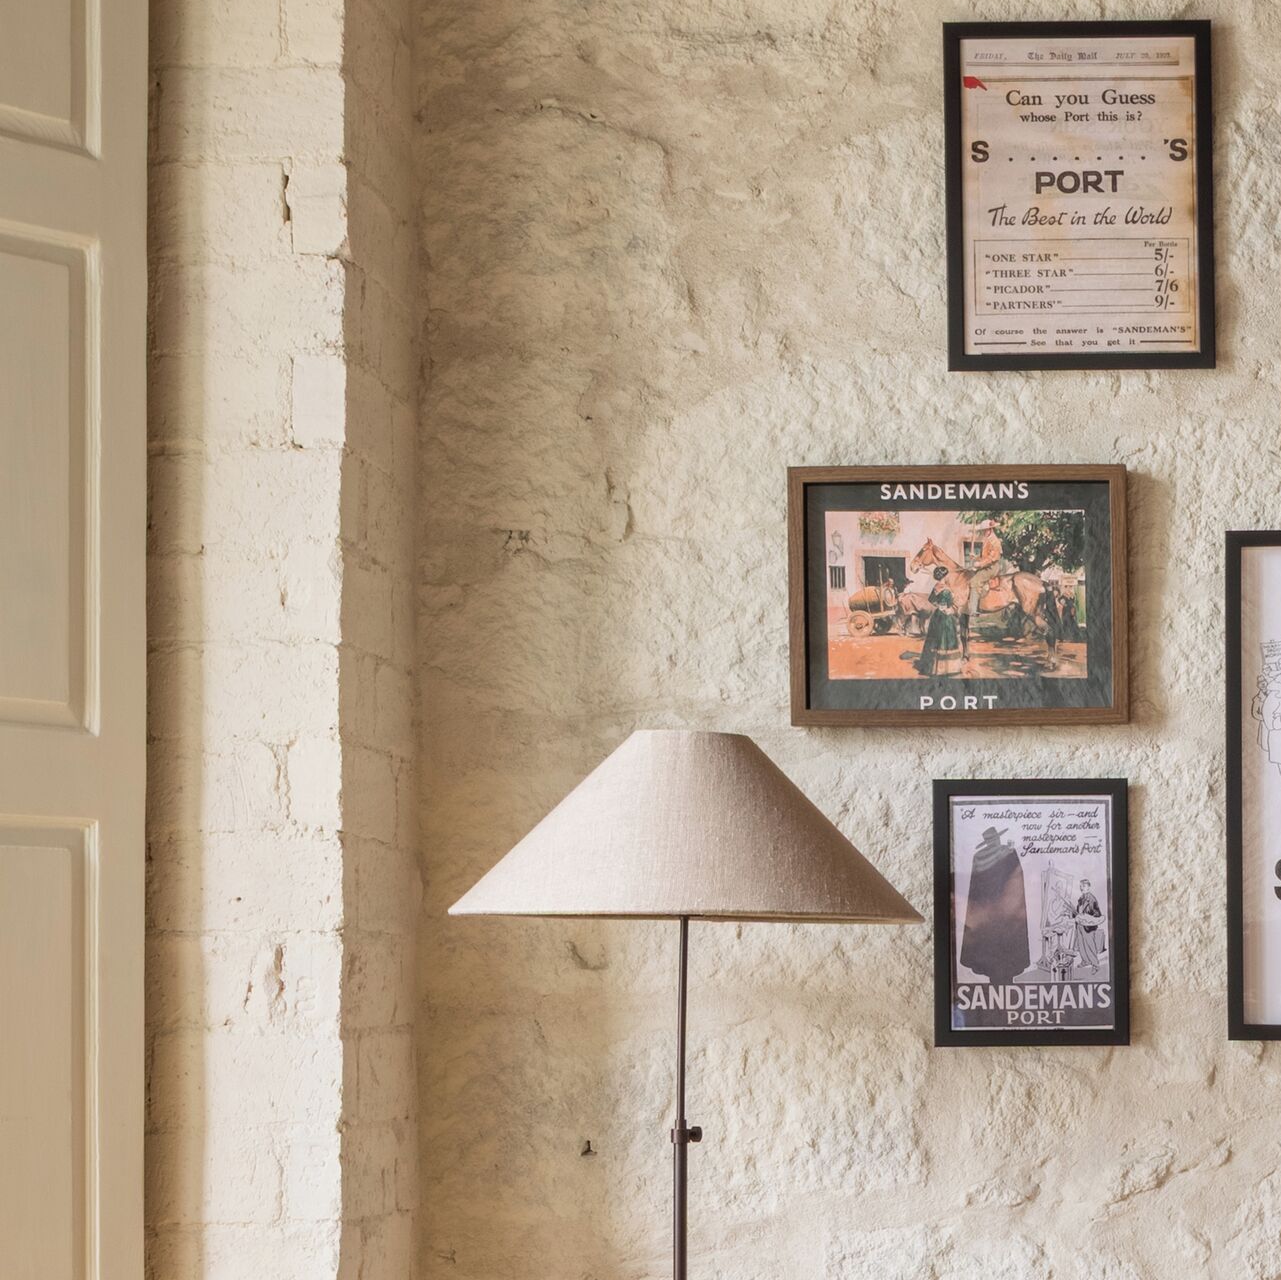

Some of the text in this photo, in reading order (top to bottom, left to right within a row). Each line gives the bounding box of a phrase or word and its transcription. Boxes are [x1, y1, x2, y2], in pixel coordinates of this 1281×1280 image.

[1026, 51, 1045, 62] The
[1006, 88, 1156, 109] Can you Guess
[1020, 110, 1143, 123] whose Port this is?
[1035, 170, 1125, 195] PORT
[988, 203, 1173, 227] The Best in the World
[1154, 248, 1174, 263] 5/-
[1154, 263, 1175, 279] 6/-
[1155, 279, 1179, 295] 7/6
[1154, 294, 1175, 311] 9/-
[975, 328, 986, 336] Of
[994, 328, 1025, 336] course
[1032, 327, 1048, 335] the
[1055, 327, 1088, 335] answer
[1096, 326, 1104, 334] is
[1030, 339, 1047, 347] See
[1081, 339, 1098, 347] you
[1106, 338, 1121, 347] get
[1128, 337, 1136, 345] it
[880, 480, 1029, 500] SANDEMAN'S
[920, 695, 998, 710] PORT
[983, 808, 1043, 822] masterpiece
[1021, 818, 1101, 835] now for another
[1021, 831, 1077, 844] masterpiece
[1020, 841, 1080, 857] Sandeman's
[956, 983, 1112, 1010] SANDEMAN'S
[1006, 1009, 1066, 1025] PORT
